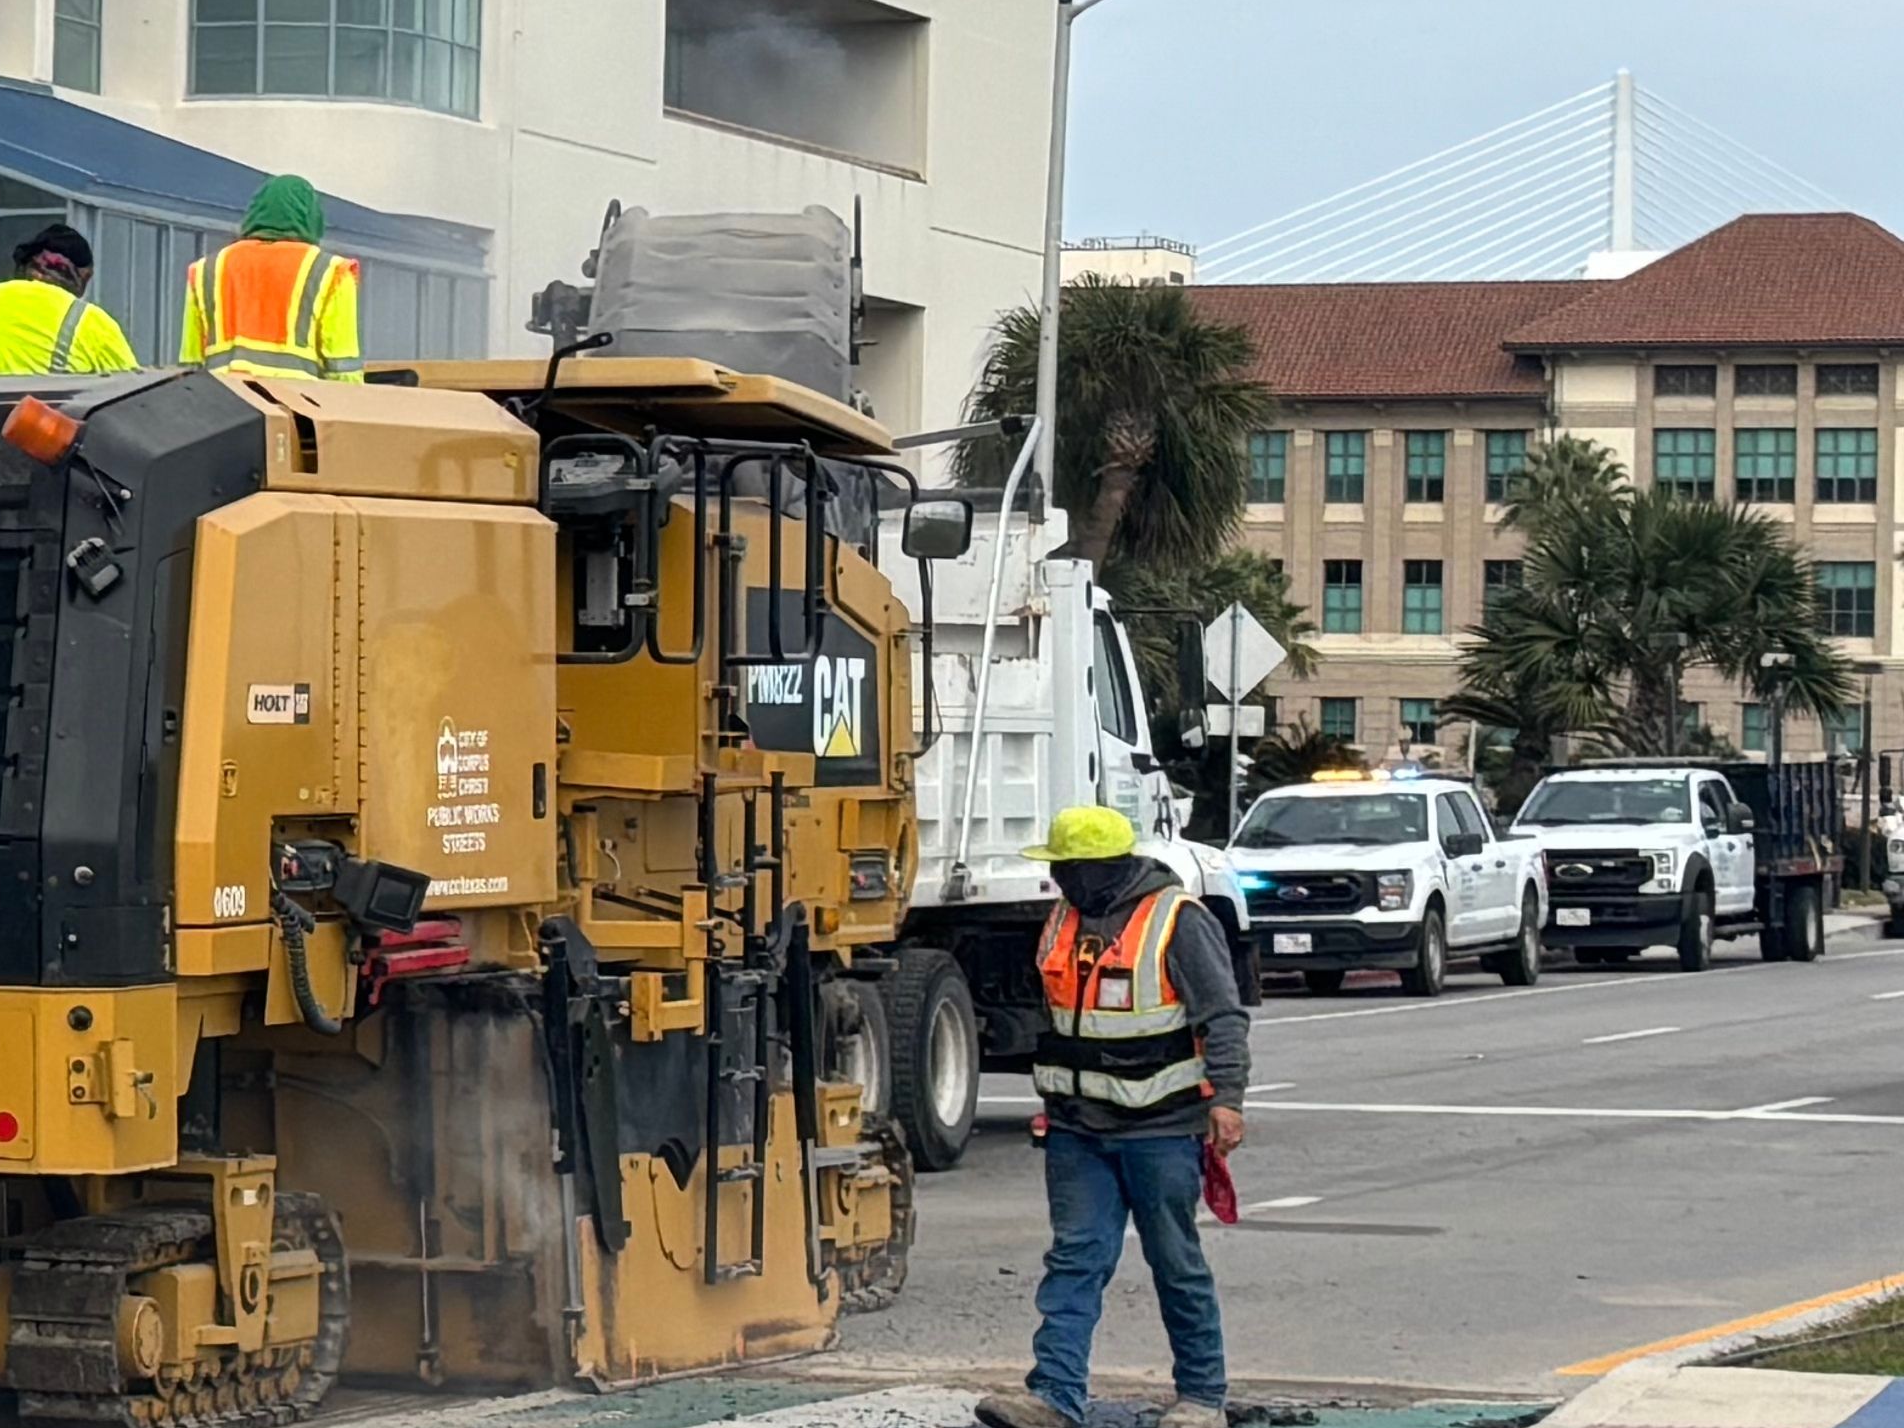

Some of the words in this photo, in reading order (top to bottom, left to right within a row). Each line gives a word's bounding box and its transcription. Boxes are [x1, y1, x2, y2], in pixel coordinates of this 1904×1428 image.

[748, 664, 803, 704] PM822
[254, 694, 290, 712] HOLT
[813, 655, 865, 757] CAT
[427, 806, 463, 827] PUBLIC
[464, 803, 500, 825] WORKS
